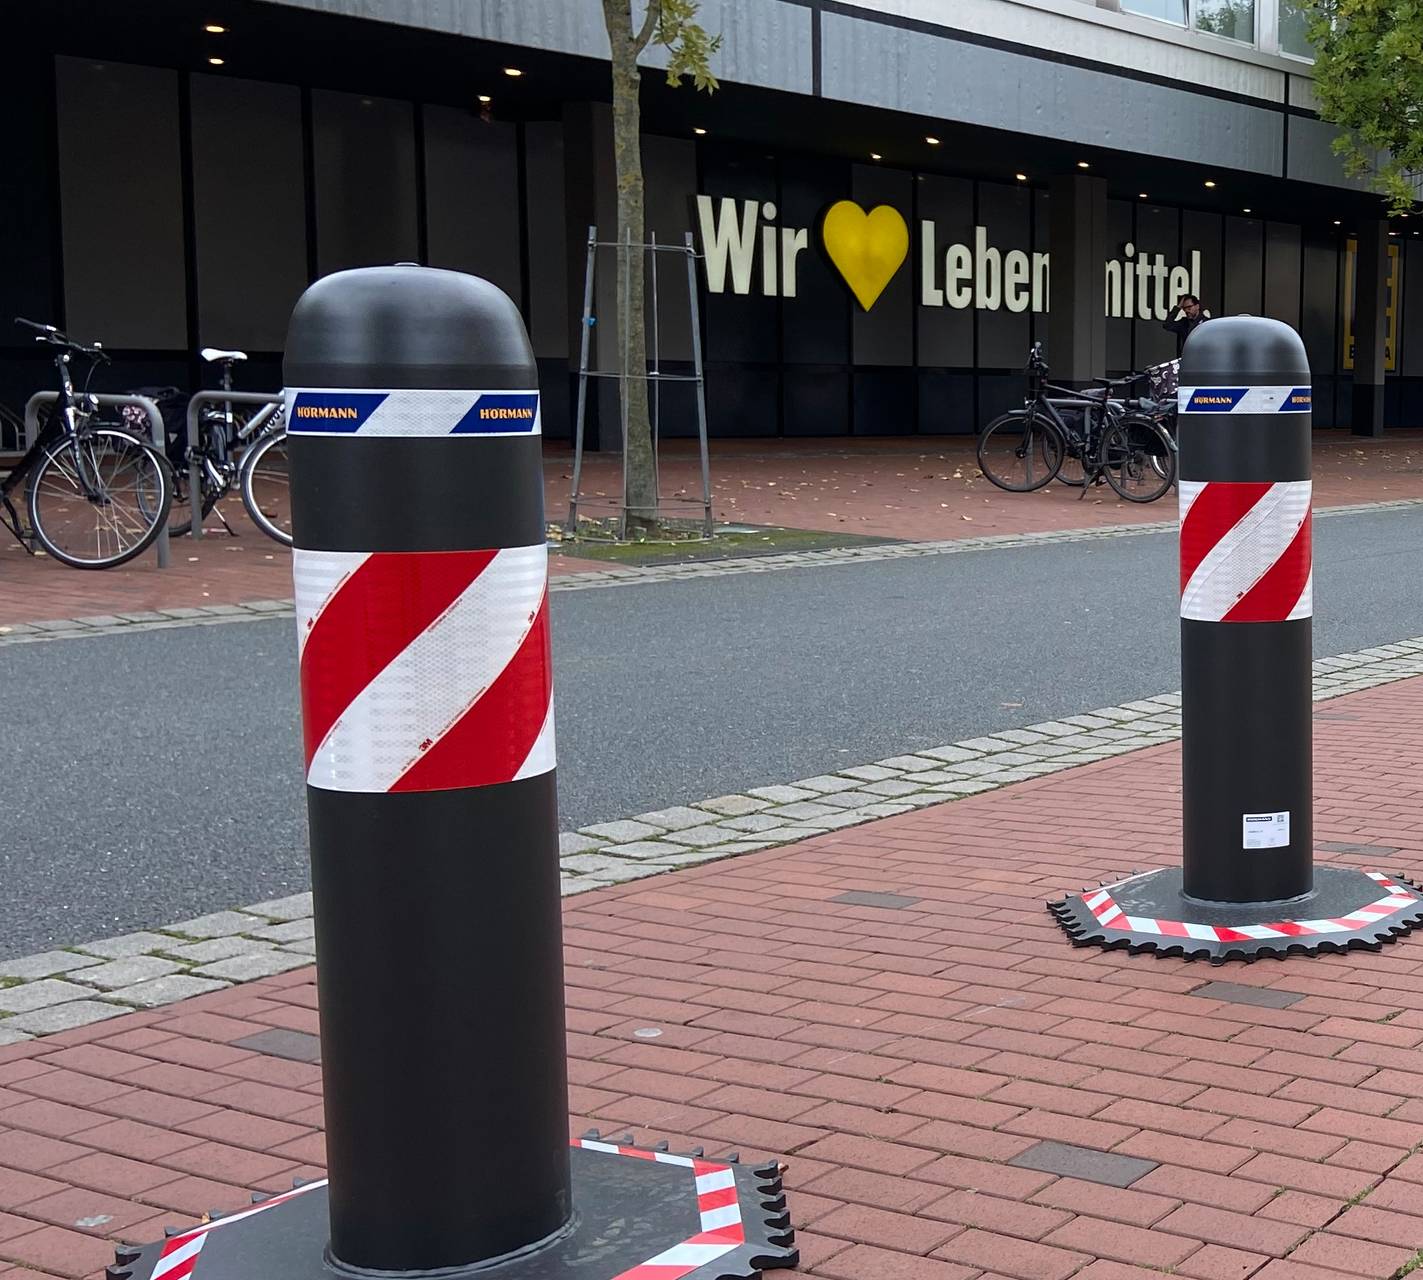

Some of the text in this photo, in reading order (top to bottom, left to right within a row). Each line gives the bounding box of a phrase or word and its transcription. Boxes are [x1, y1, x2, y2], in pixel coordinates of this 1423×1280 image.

[696, 194, 808, 298] Wir
[297, 405, 358, 419] HÖRMANN
[480, 407, 533, 420] HÖRMANN
[418, 738, 433, 752] 3M
